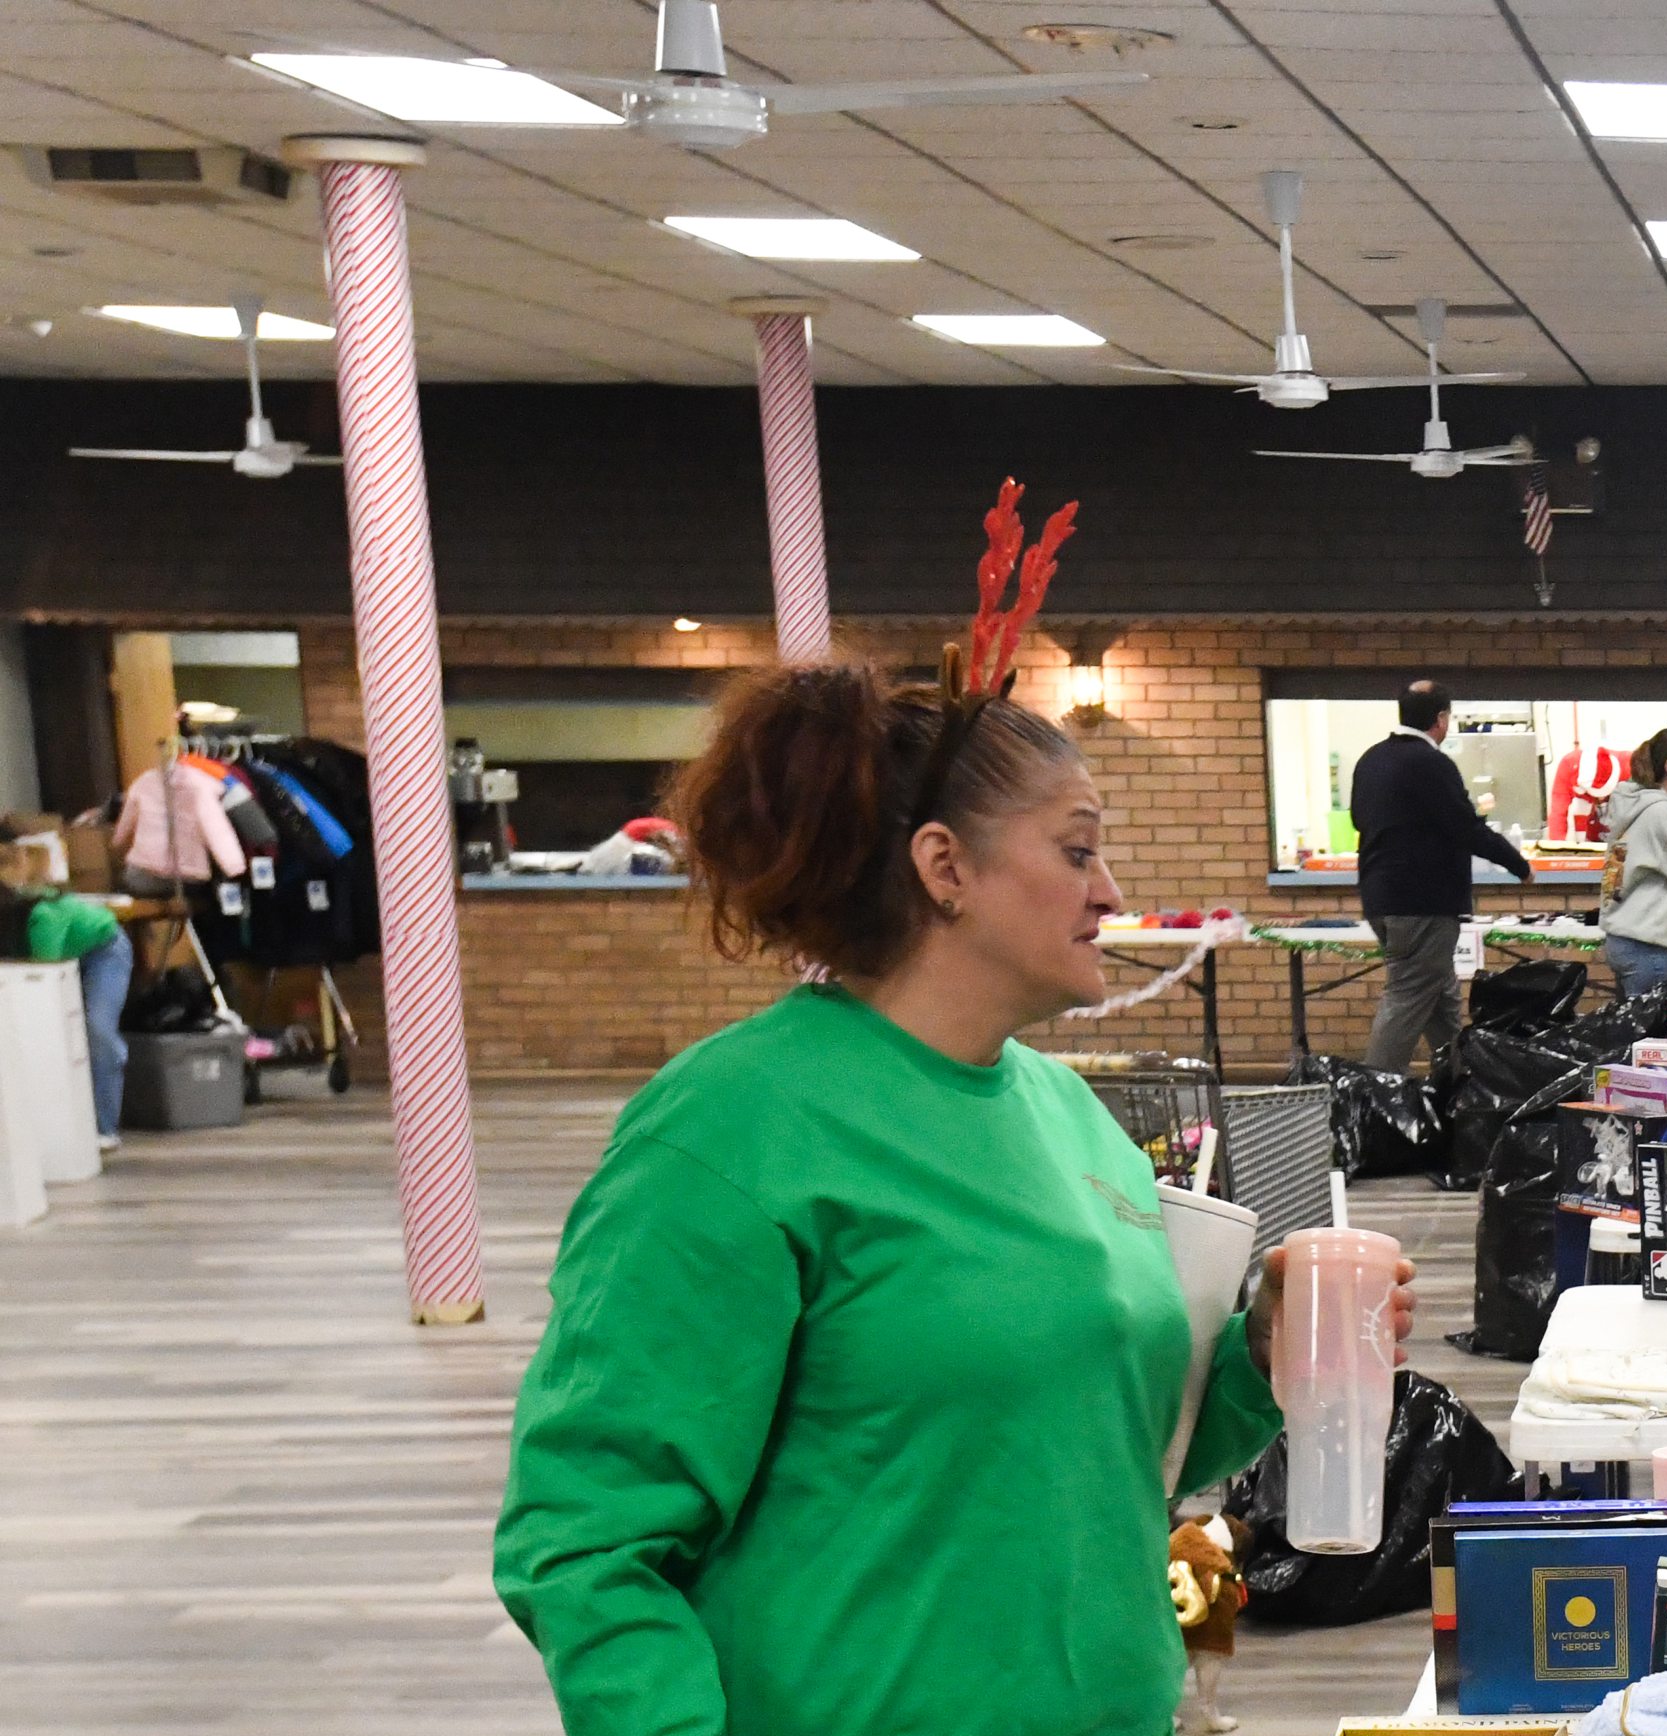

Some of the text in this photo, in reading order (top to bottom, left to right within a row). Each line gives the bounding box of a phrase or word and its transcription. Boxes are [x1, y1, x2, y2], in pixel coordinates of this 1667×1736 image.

[1641, 1050, 1664, 1060] REAL
[1641, 1157, 1664, 1239] PINBALL
[1551, 1631, 1610, 1641] VICTORIOUS
[1561, 1642, 1601, 1651] HEROES
